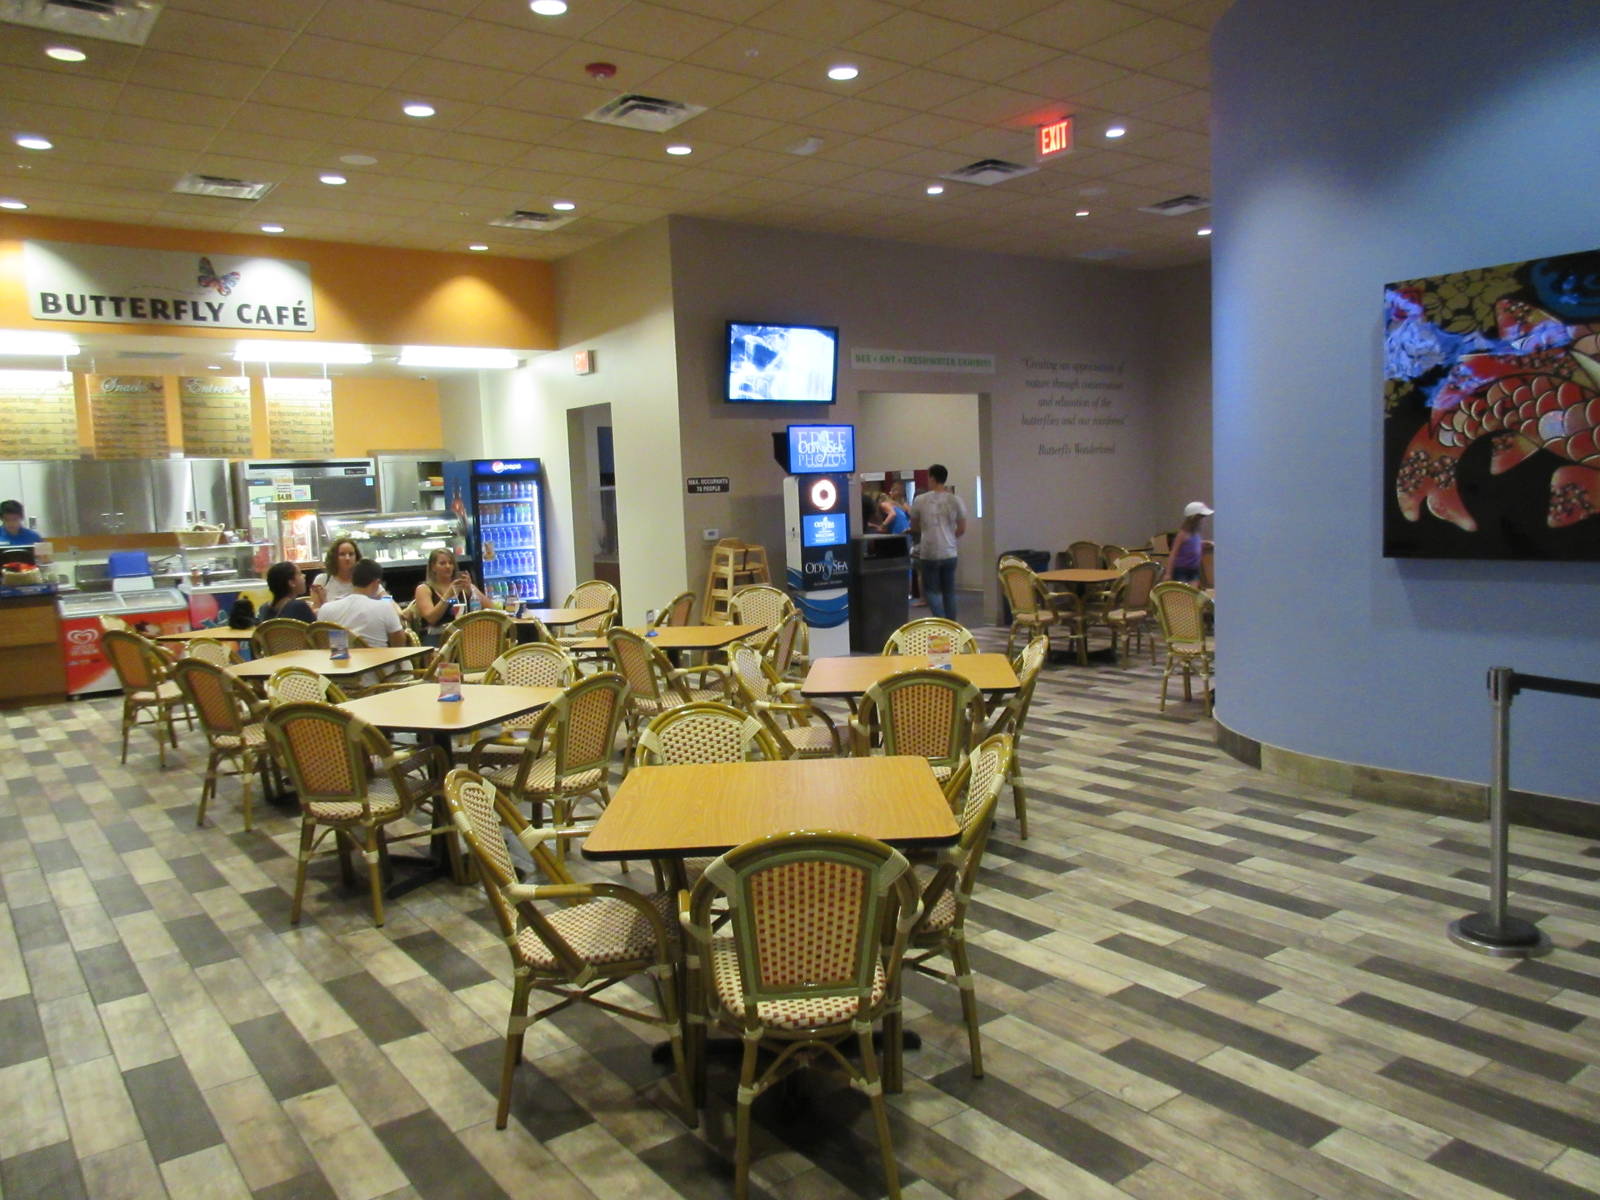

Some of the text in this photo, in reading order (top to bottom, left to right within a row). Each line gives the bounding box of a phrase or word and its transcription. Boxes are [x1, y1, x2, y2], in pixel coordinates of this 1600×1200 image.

[1041, 122, 1067, 155] EXIT
[40, 291, 308, 327] BUTTERFLY CAFÉ
